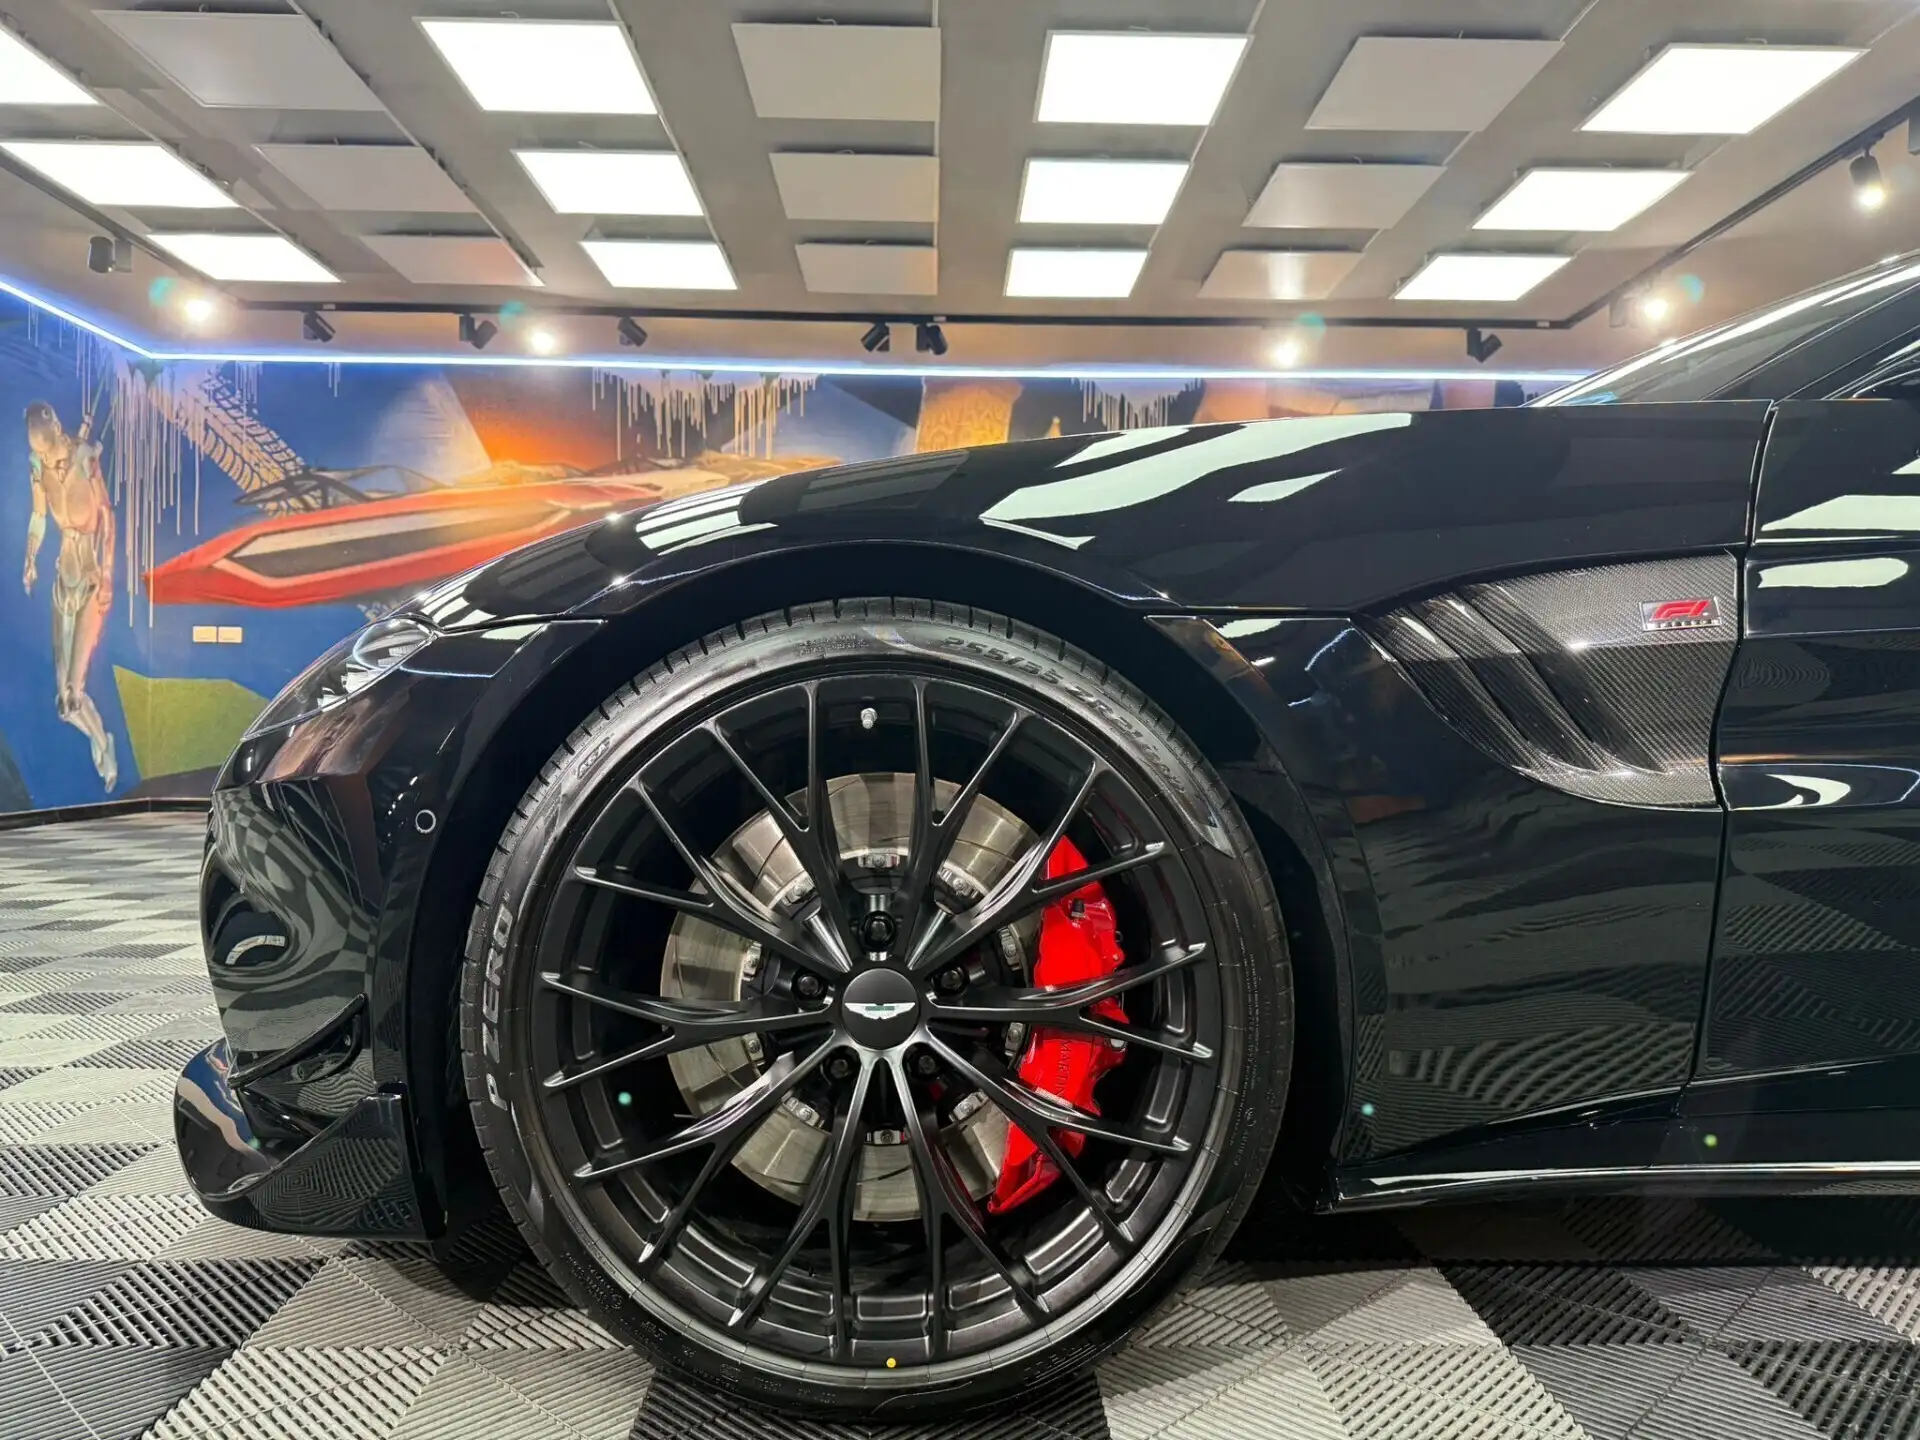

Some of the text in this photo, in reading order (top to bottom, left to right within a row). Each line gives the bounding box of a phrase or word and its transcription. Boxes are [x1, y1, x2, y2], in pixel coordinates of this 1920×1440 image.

[1649, 597, 1711, 622] F1
[940, 636, 1065, 685] 255/35
[481, 902, 514, 1111] P ZERO
[1053, 1039, 1073, 1098] MARTIN
